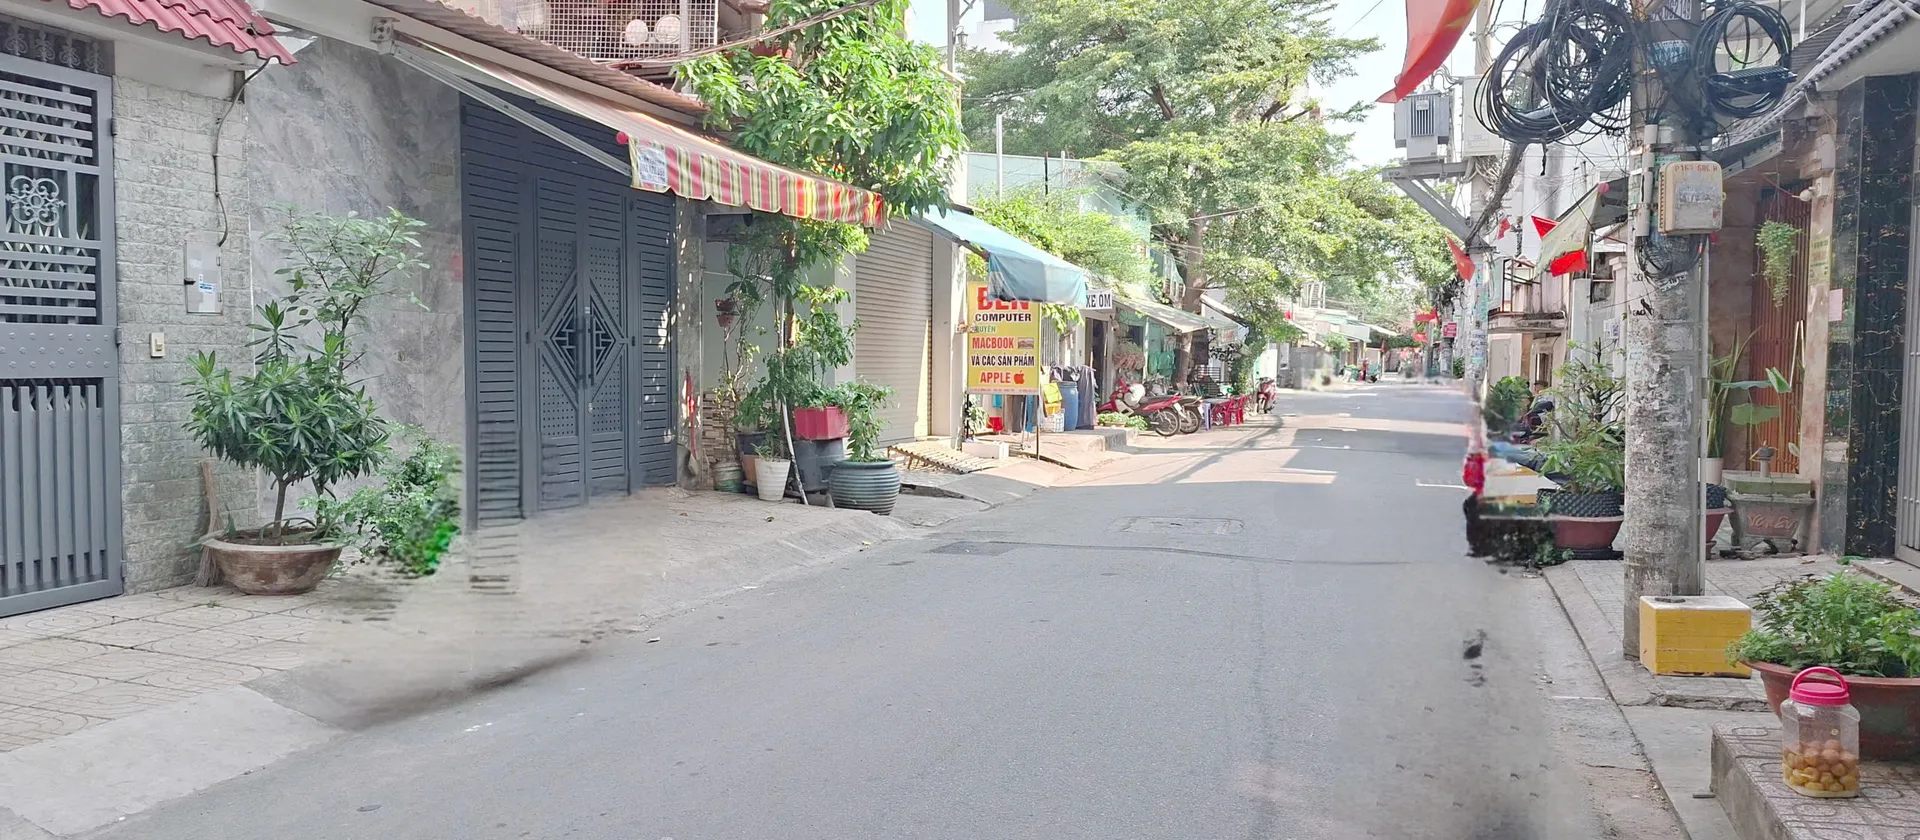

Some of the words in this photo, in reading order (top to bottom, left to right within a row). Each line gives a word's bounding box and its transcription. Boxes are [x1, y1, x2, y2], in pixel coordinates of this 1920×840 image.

[1085, 294, 1096, 308] XE
[975, 313, 1032, 322] COMPUTER
[975, 324, 996, 333] UYÊN
[972, 337, 1014, 349] MACBOOK
[971, 353, 980, 366] VÀ
[981, 353, 996, 366] CÁC
[997, 352, 1012, 366] SẢN
[980, 371, 1011, 384] APPLE
